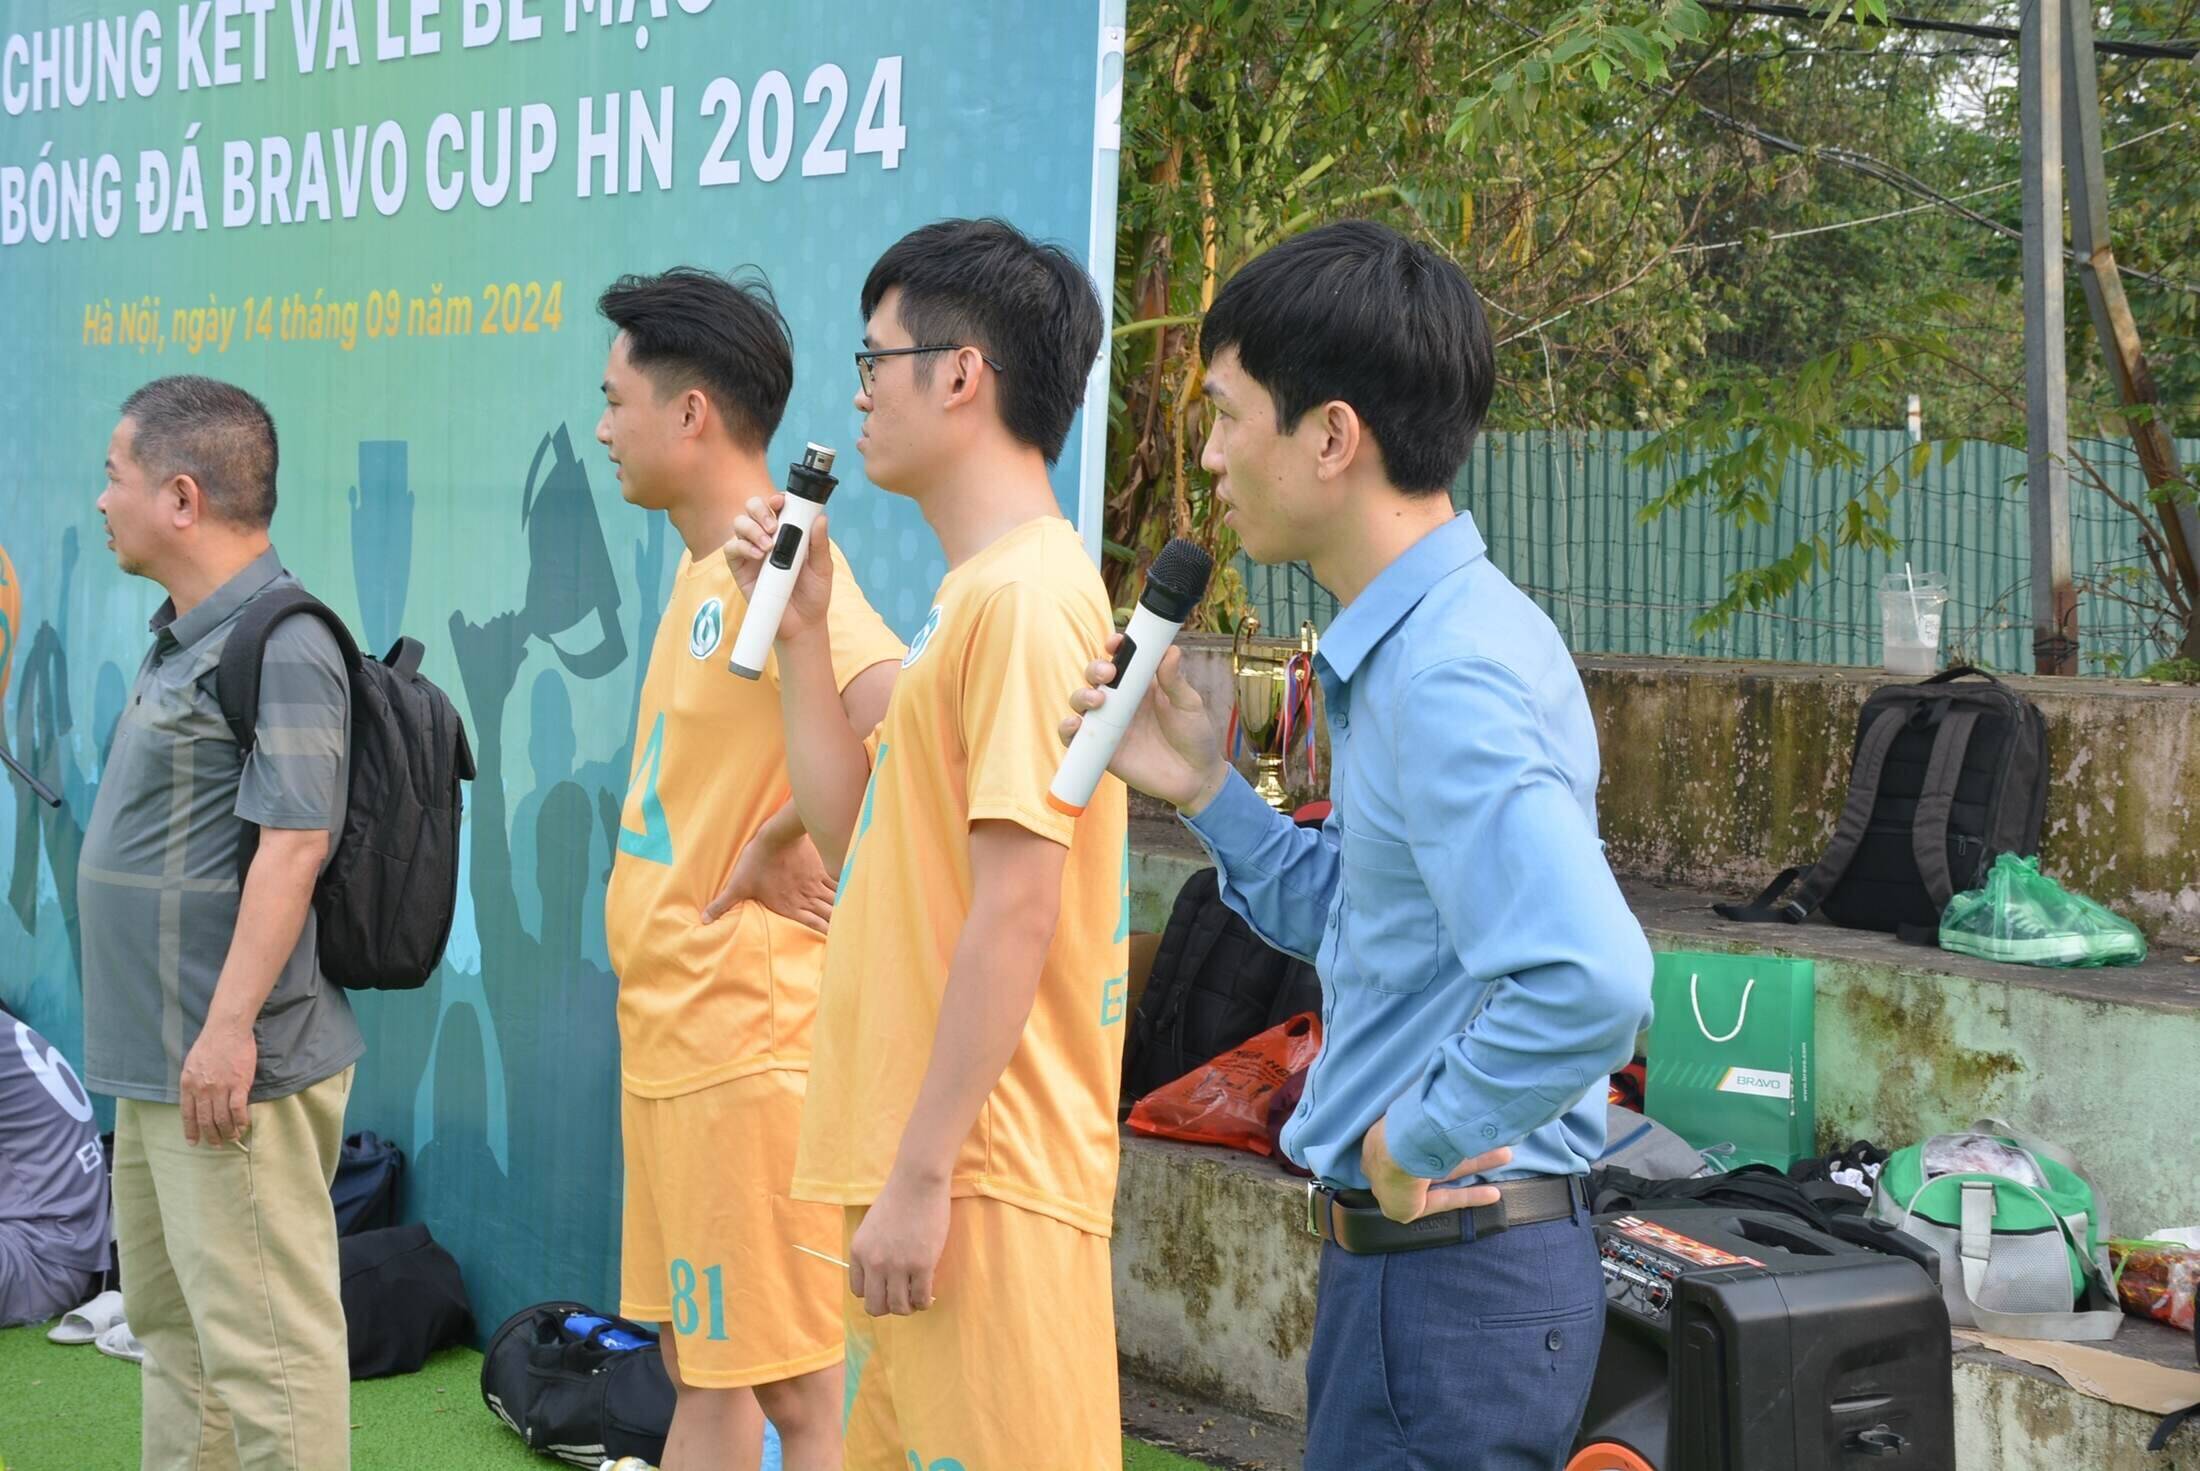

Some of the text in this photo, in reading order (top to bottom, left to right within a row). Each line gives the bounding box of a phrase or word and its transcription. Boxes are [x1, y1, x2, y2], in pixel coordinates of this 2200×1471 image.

[2, 9, 163, 116] CHUNG
[0, 55, 907, 245] BÓNG ĐÁ BRAVO CUP HN 2024
[82, 279, 564, 354] Hà Nội, ngày 14 tháng 09 năm 2024
[14, 1021, 94, 1123] 6
[1736, 1075, 1781, 1090] BRAVO
[671, 1258, 730, 1341] 81
